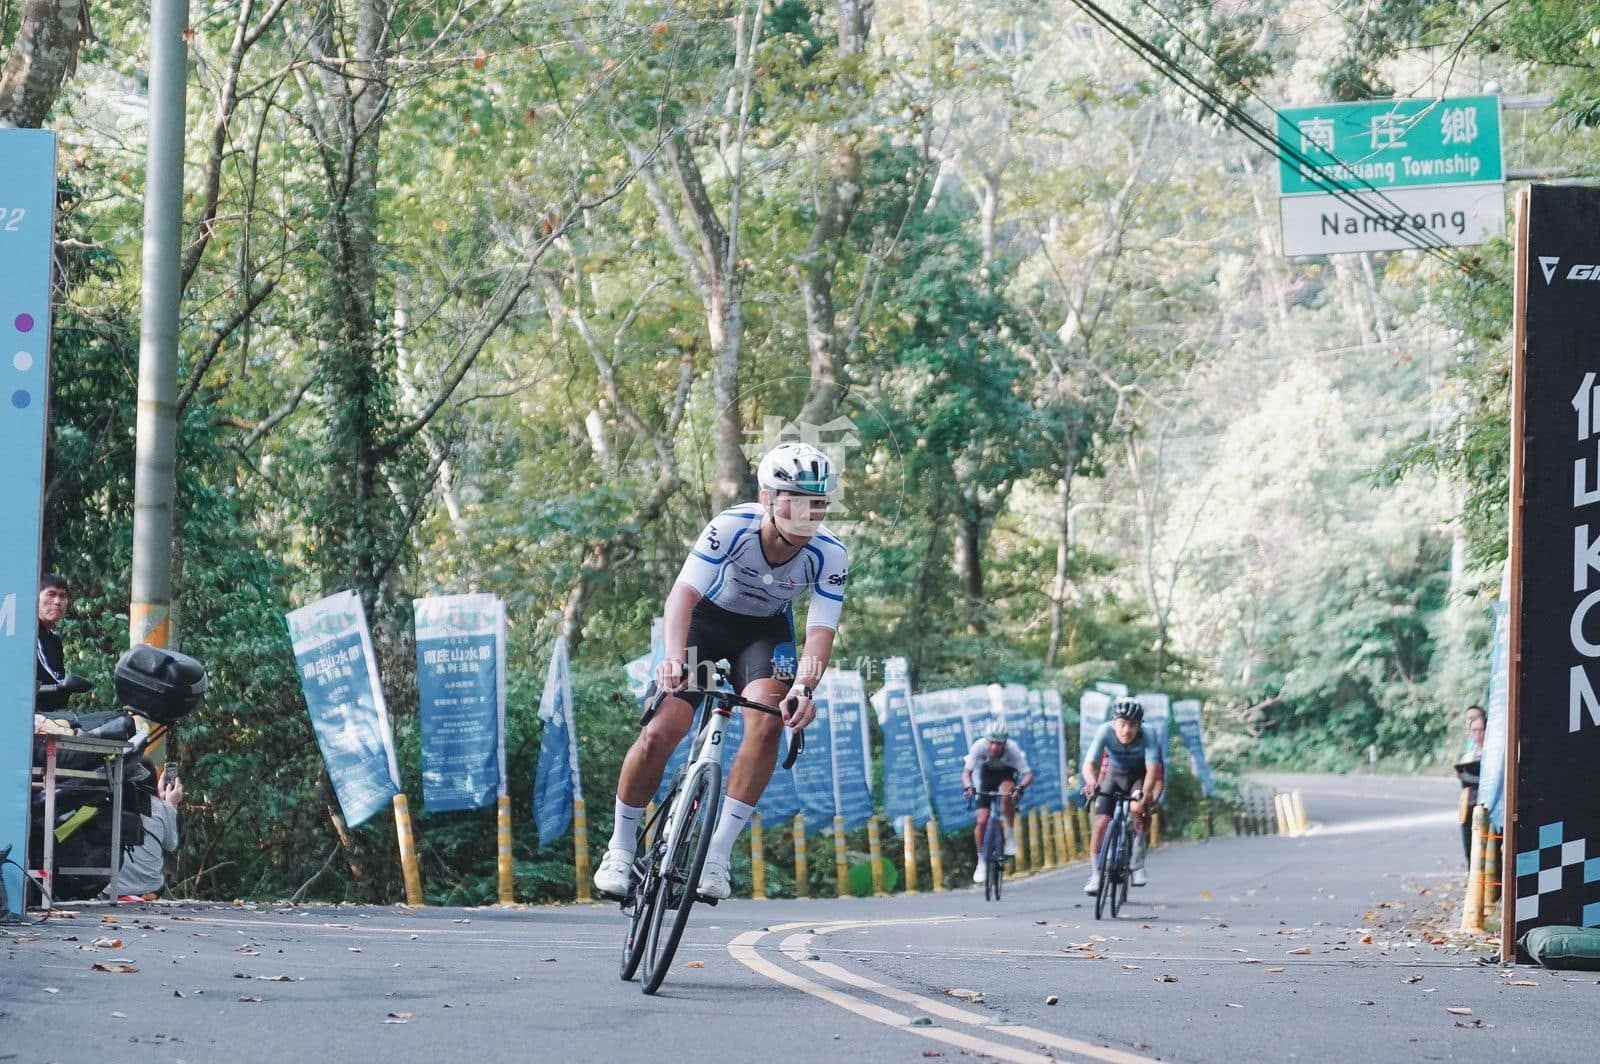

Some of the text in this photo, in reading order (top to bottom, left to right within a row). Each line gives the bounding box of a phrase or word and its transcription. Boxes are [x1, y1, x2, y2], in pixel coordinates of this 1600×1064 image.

[1298, 106, 1479, 154] 南庄鄉
[1401, 153, 1480, 176] Township
